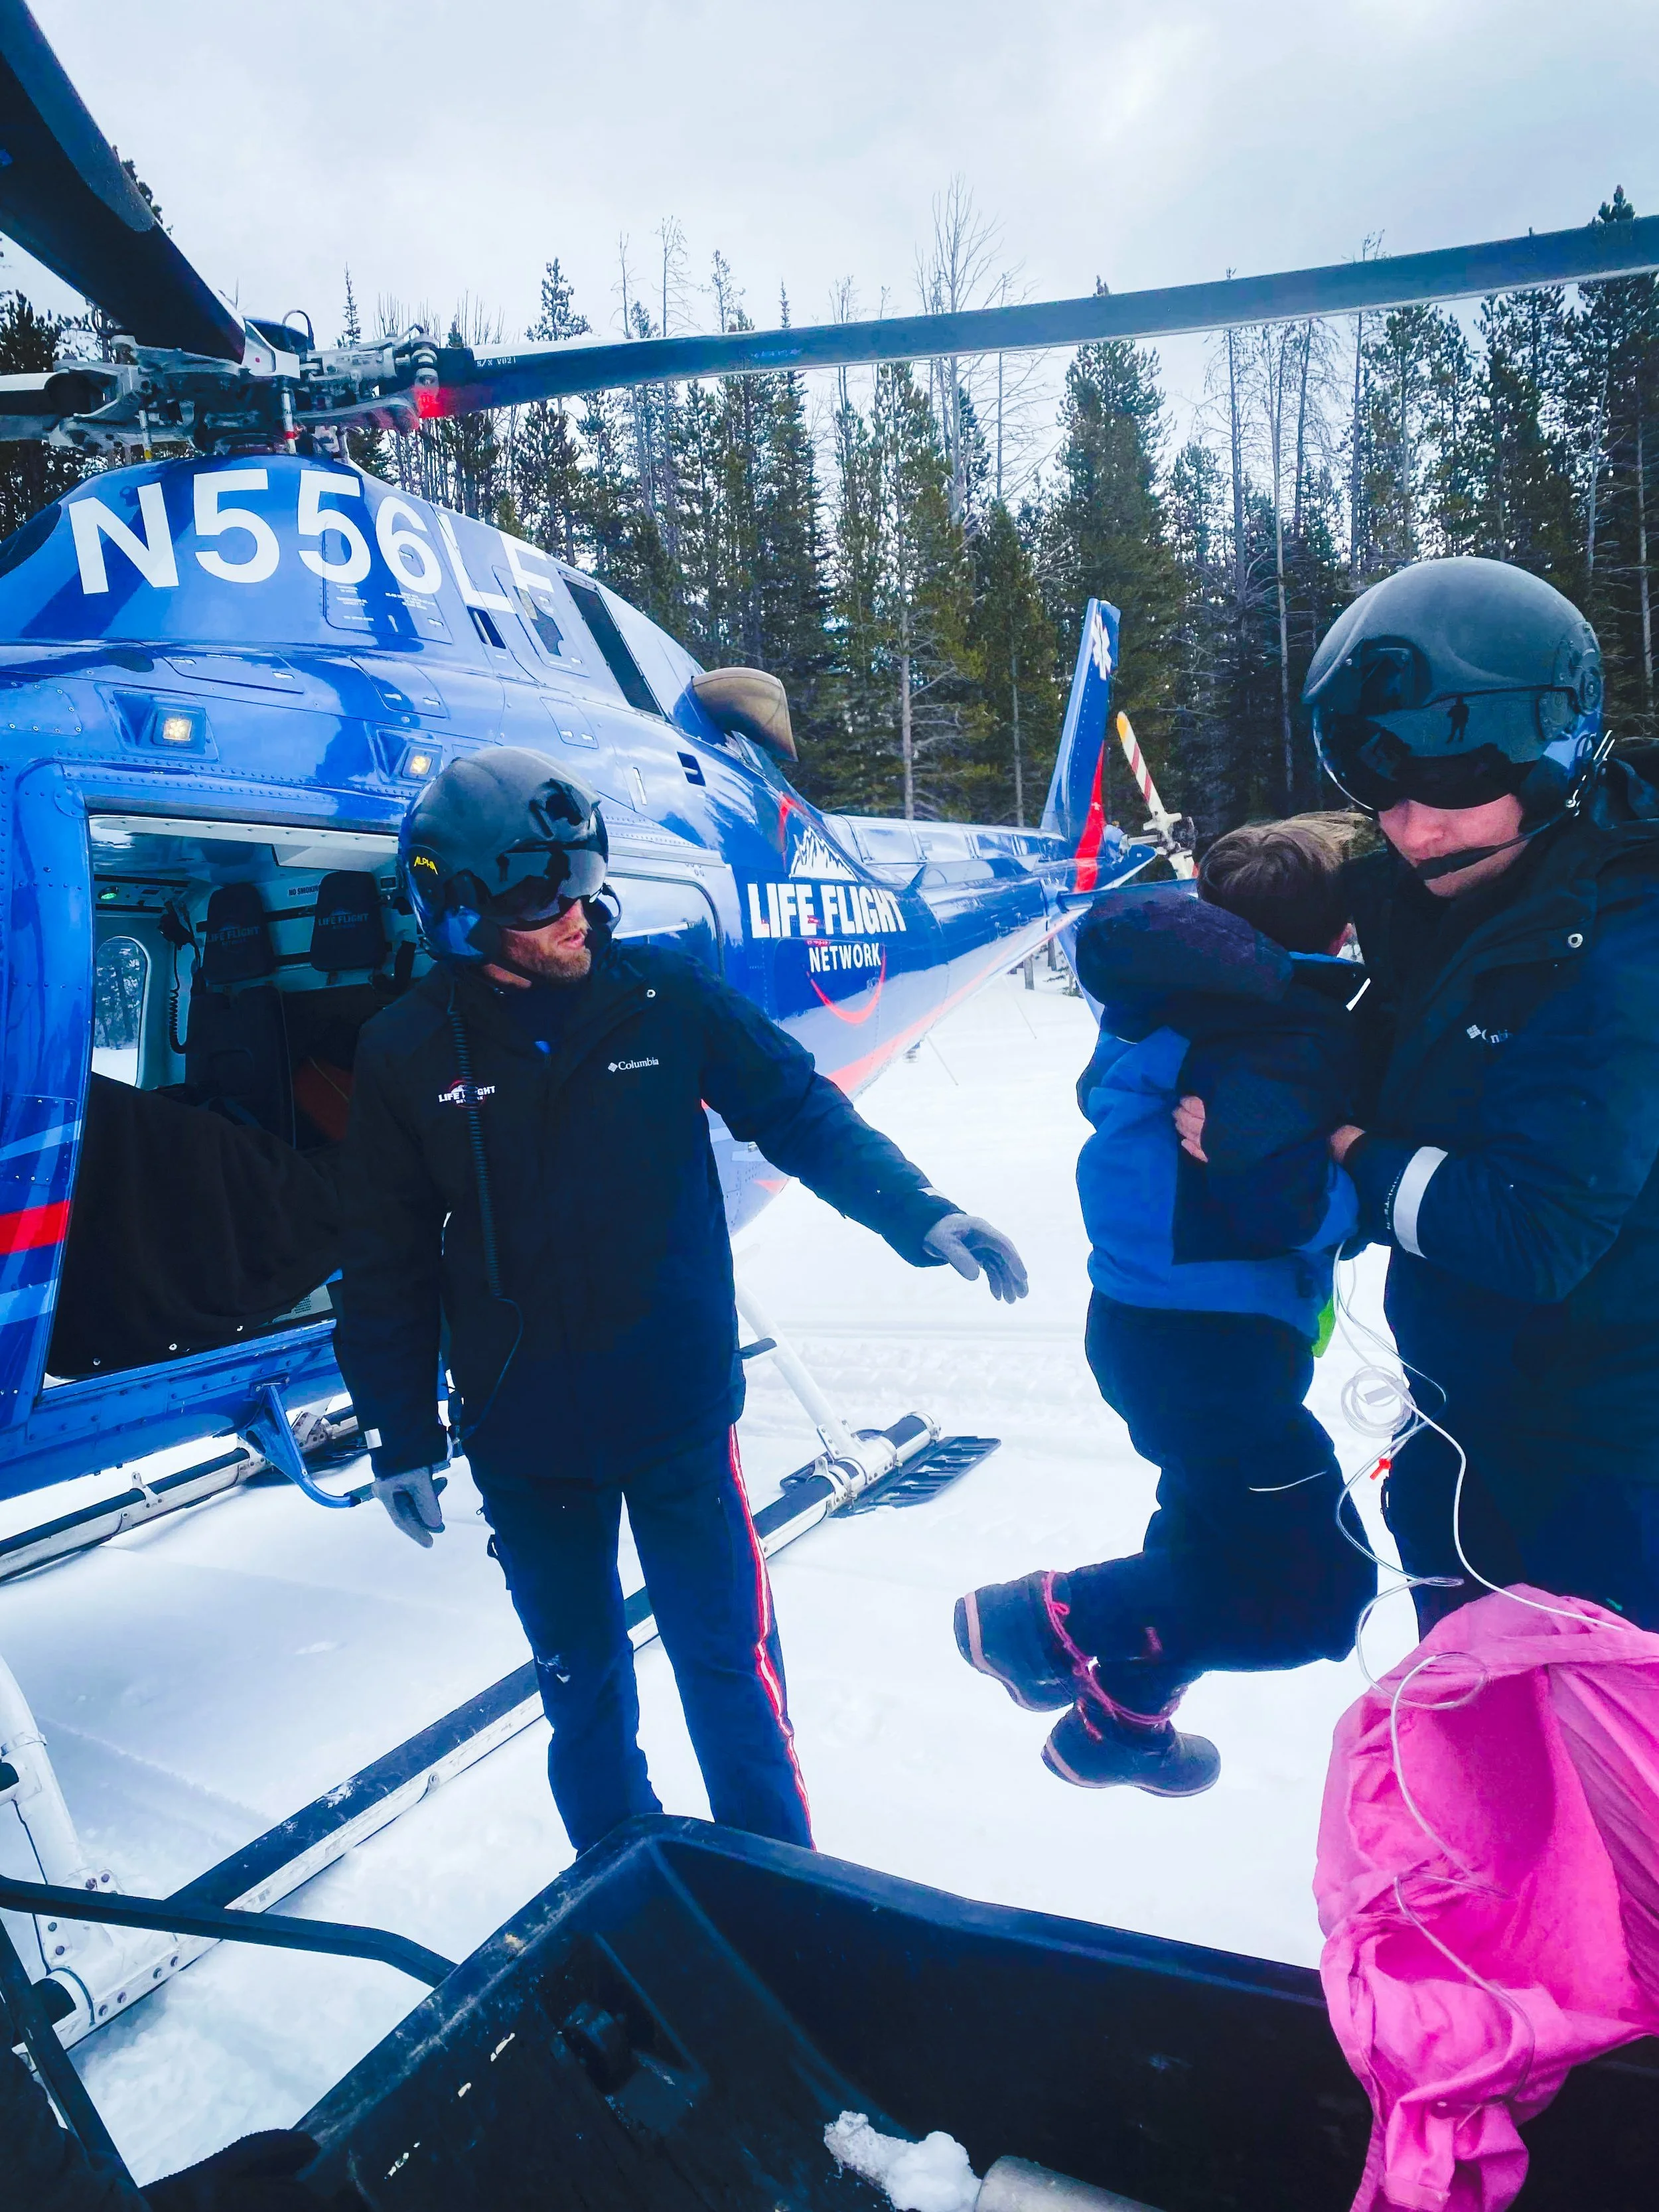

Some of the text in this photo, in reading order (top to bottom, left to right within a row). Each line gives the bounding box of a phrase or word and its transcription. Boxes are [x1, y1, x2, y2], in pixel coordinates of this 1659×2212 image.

[68, 469, 555, 615] N556LF
[414, 856, 438, 875] ALPHA
[297, 885, 319, 895] SMOKIN
[338, 913, 369, 924] FLIGHT
[747, 883, 907, 938] LIFE FLIGHT
[809, 943, 881, 973] NETWORK
[618, 1057, 659, 1070] Columbia
[439, 1092, 460, 1102] LIFE
